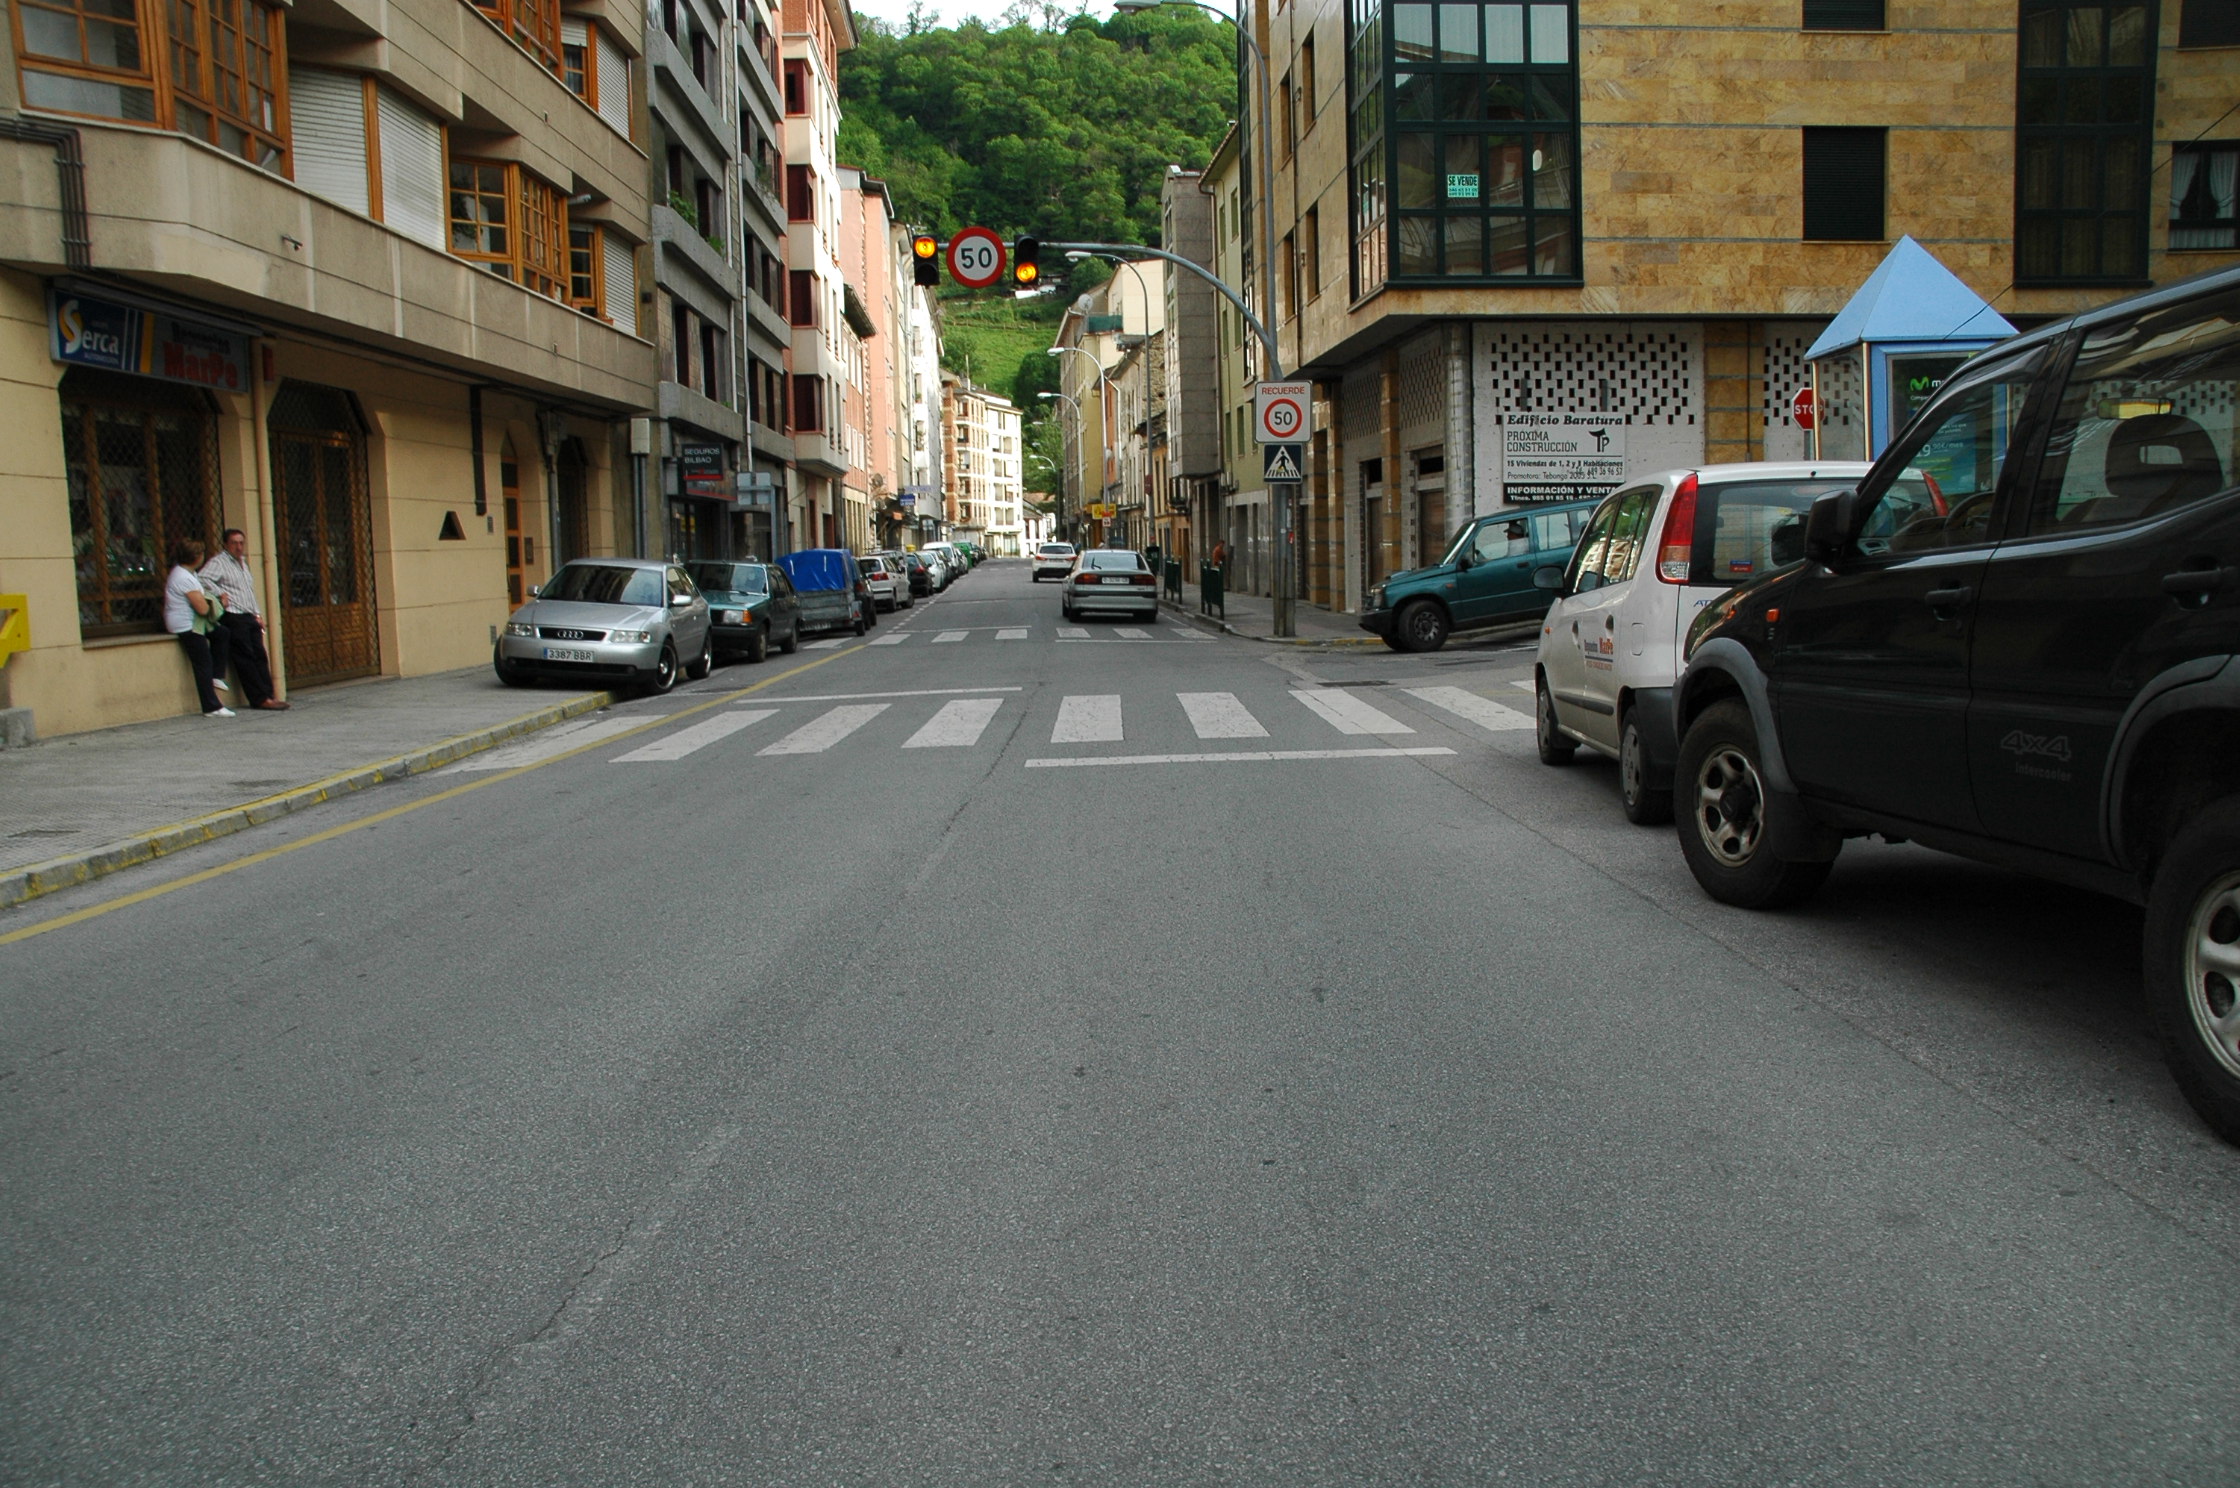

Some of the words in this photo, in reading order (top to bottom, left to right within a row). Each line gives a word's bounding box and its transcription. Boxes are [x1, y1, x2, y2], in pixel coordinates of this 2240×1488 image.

[1448, 176, 1456, 186] SE
[1457, 176, 1477, 186] VENDE
[961, 247, 992, 269] 50
[65, 299, 120, 355] Serca
[1262, 387, 1305, 395] RECUERDE
[1274, 411, 1293, 426] 50
[1507, 414, 1560, 427] Edificio
[1563, 414, 1623, 426] Baratura
[1583, 460, 1624, 468] Habitaciones
[1507, 485, 1574, 494] INFORMACIÓN
[1577, 486, 1584, 494] Y
[549, 650, 571, 659] 3387
